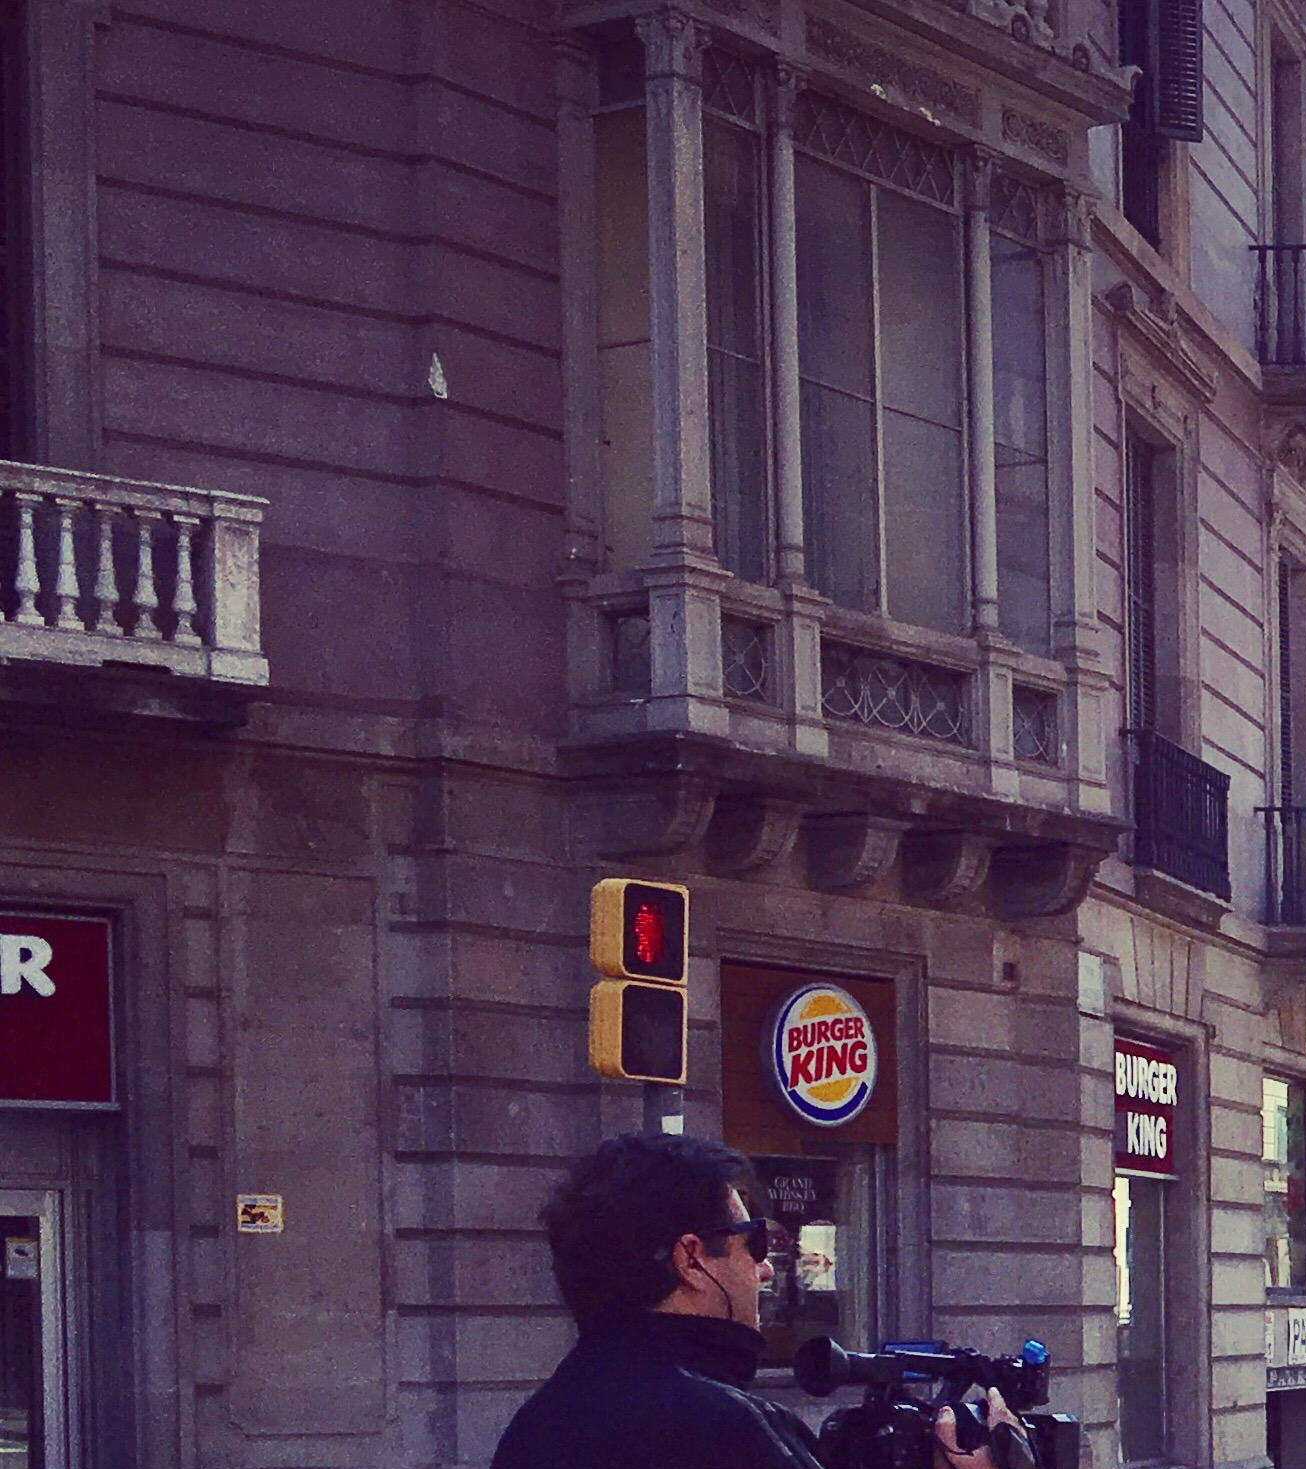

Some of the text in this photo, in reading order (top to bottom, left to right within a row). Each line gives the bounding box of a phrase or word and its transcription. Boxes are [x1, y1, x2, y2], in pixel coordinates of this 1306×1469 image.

[788, 1016, 865, 1053] BURGER
[789, 1040, 868, 1089] KING
[1115, 1052, 1178, 1106] BURGER
[1126, 1111, 1168, 1159] KING
[768, 1188, 817, 1201] WHISKEY
[774, 1176, 812, 1189] GRAND
